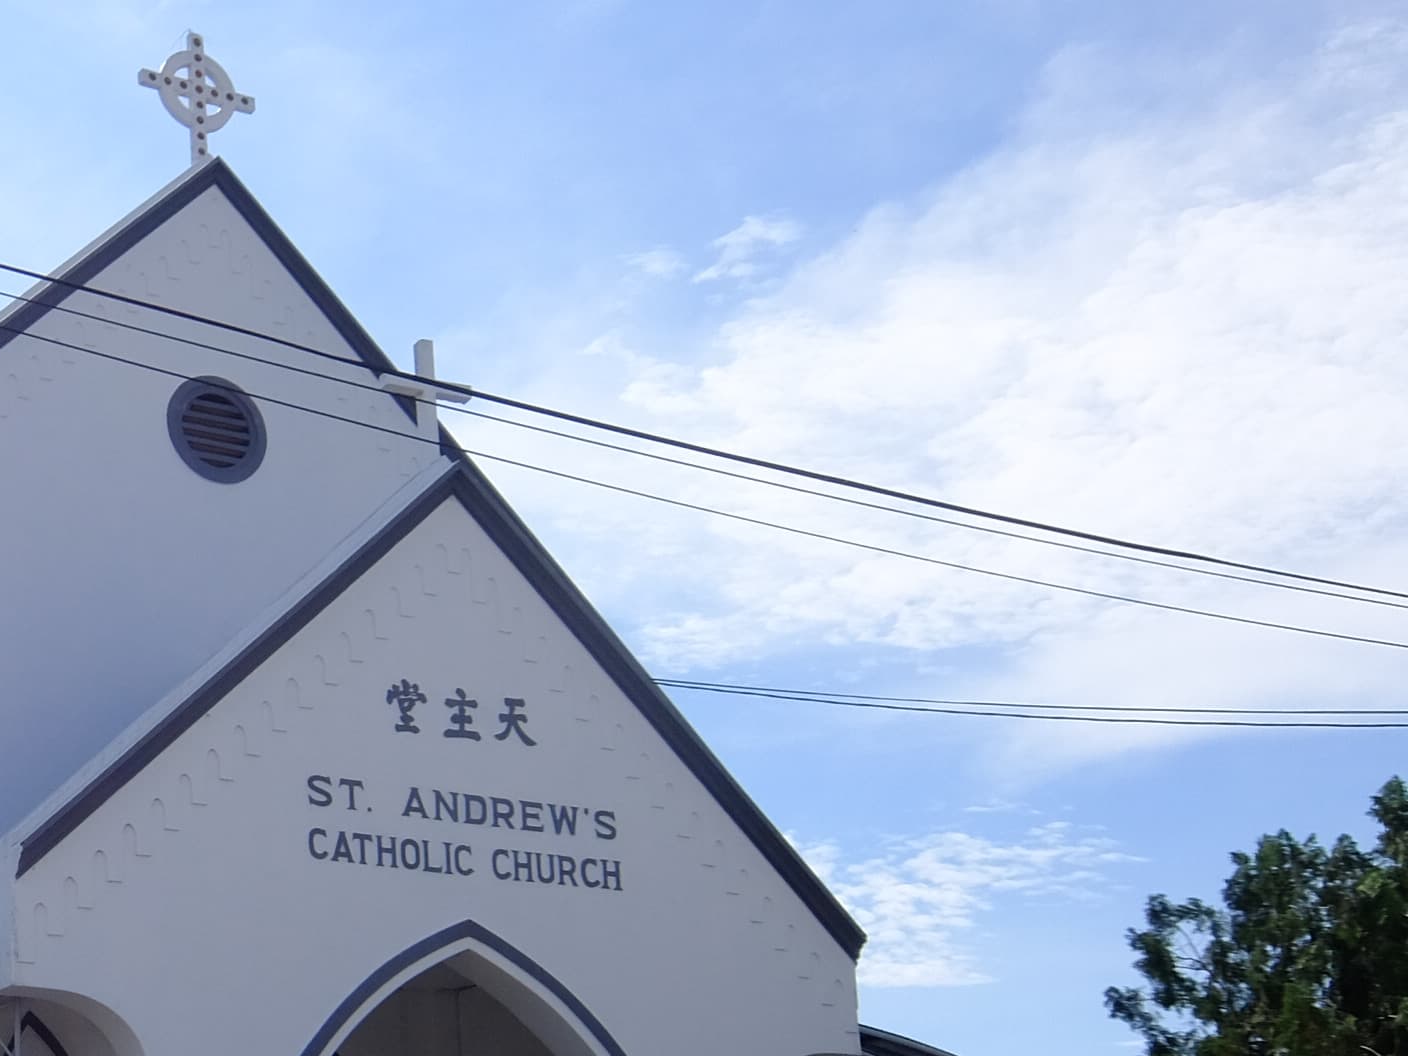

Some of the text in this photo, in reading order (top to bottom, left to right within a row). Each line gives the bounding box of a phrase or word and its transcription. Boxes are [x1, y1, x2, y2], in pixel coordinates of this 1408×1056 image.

[306, 774, 618, 840] ST. ANDREW'S
[308, 827, 624, 892] CATHOLIC CHURCH
